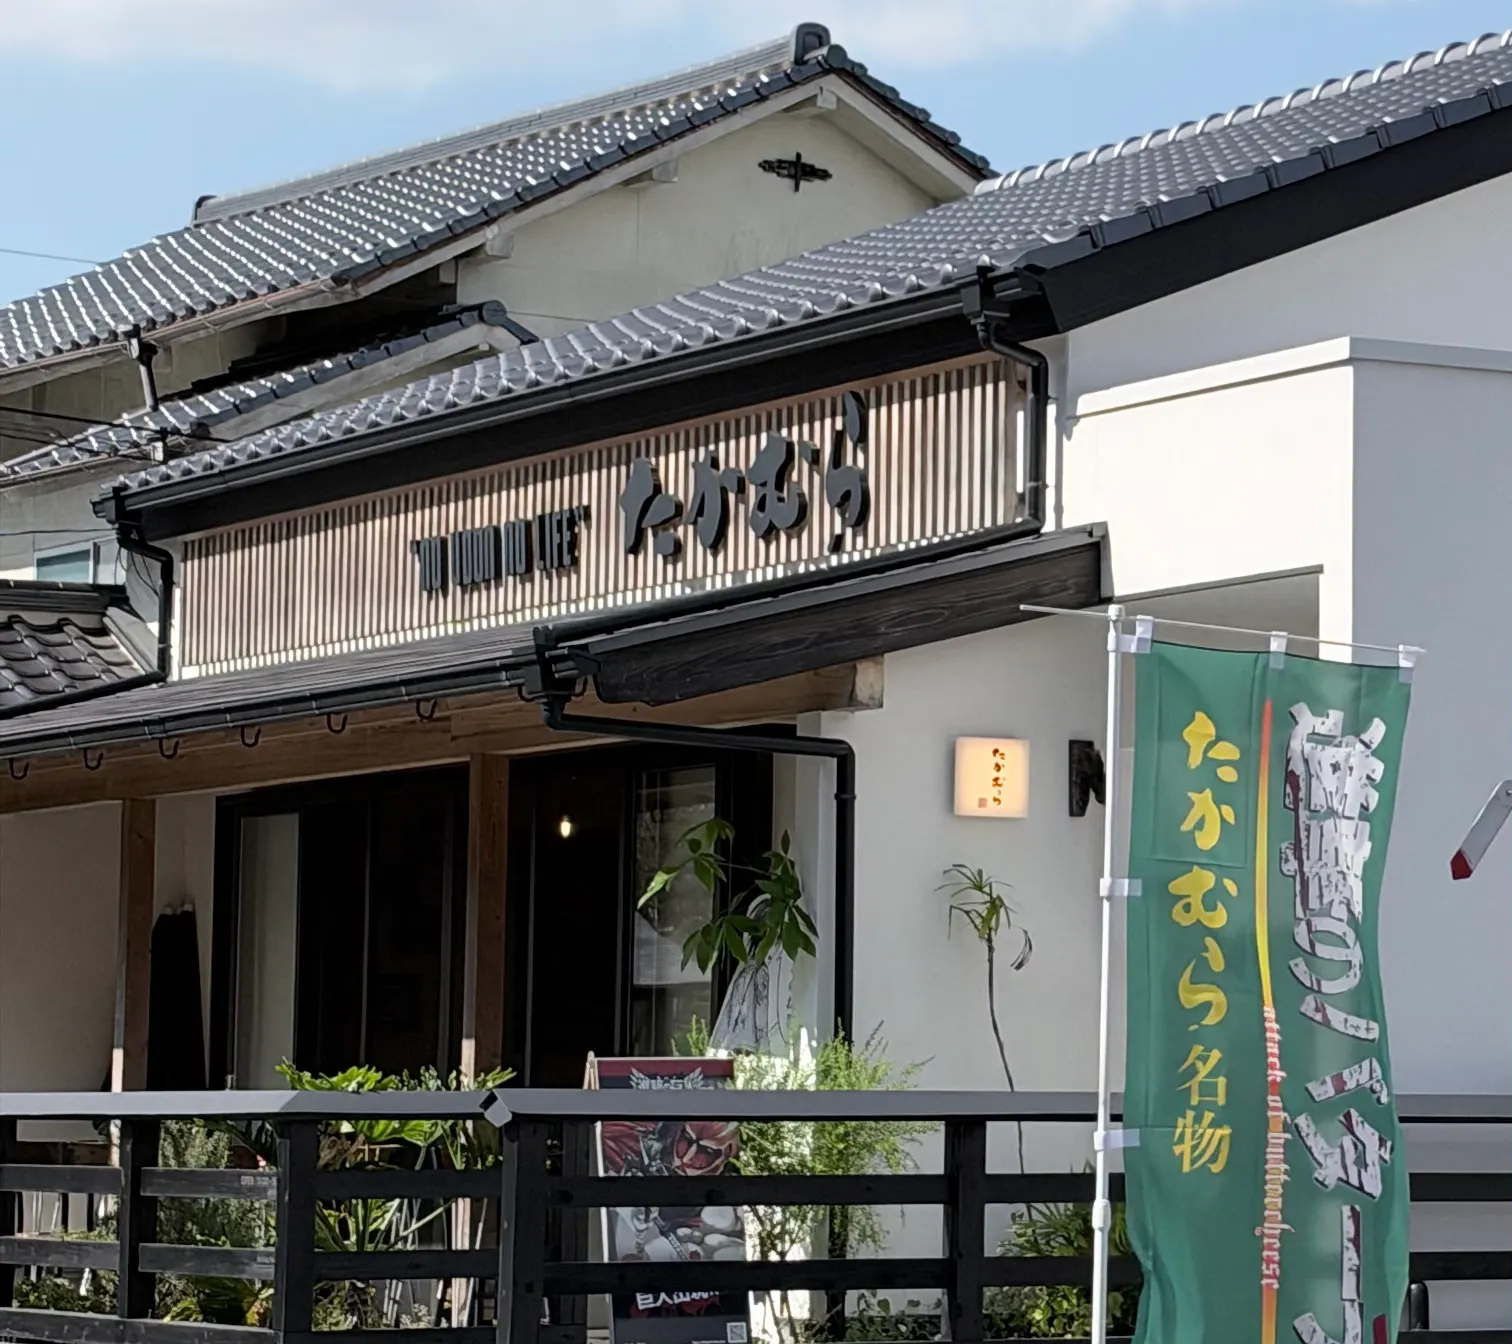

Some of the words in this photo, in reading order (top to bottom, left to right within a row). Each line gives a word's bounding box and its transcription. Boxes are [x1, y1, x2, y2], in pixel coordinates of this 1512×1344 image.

[620, 391, 870, 554] たかむら
[451, 525, 499, 586] UDON
[1168, 711, 1240, 1174] たかむら名物
